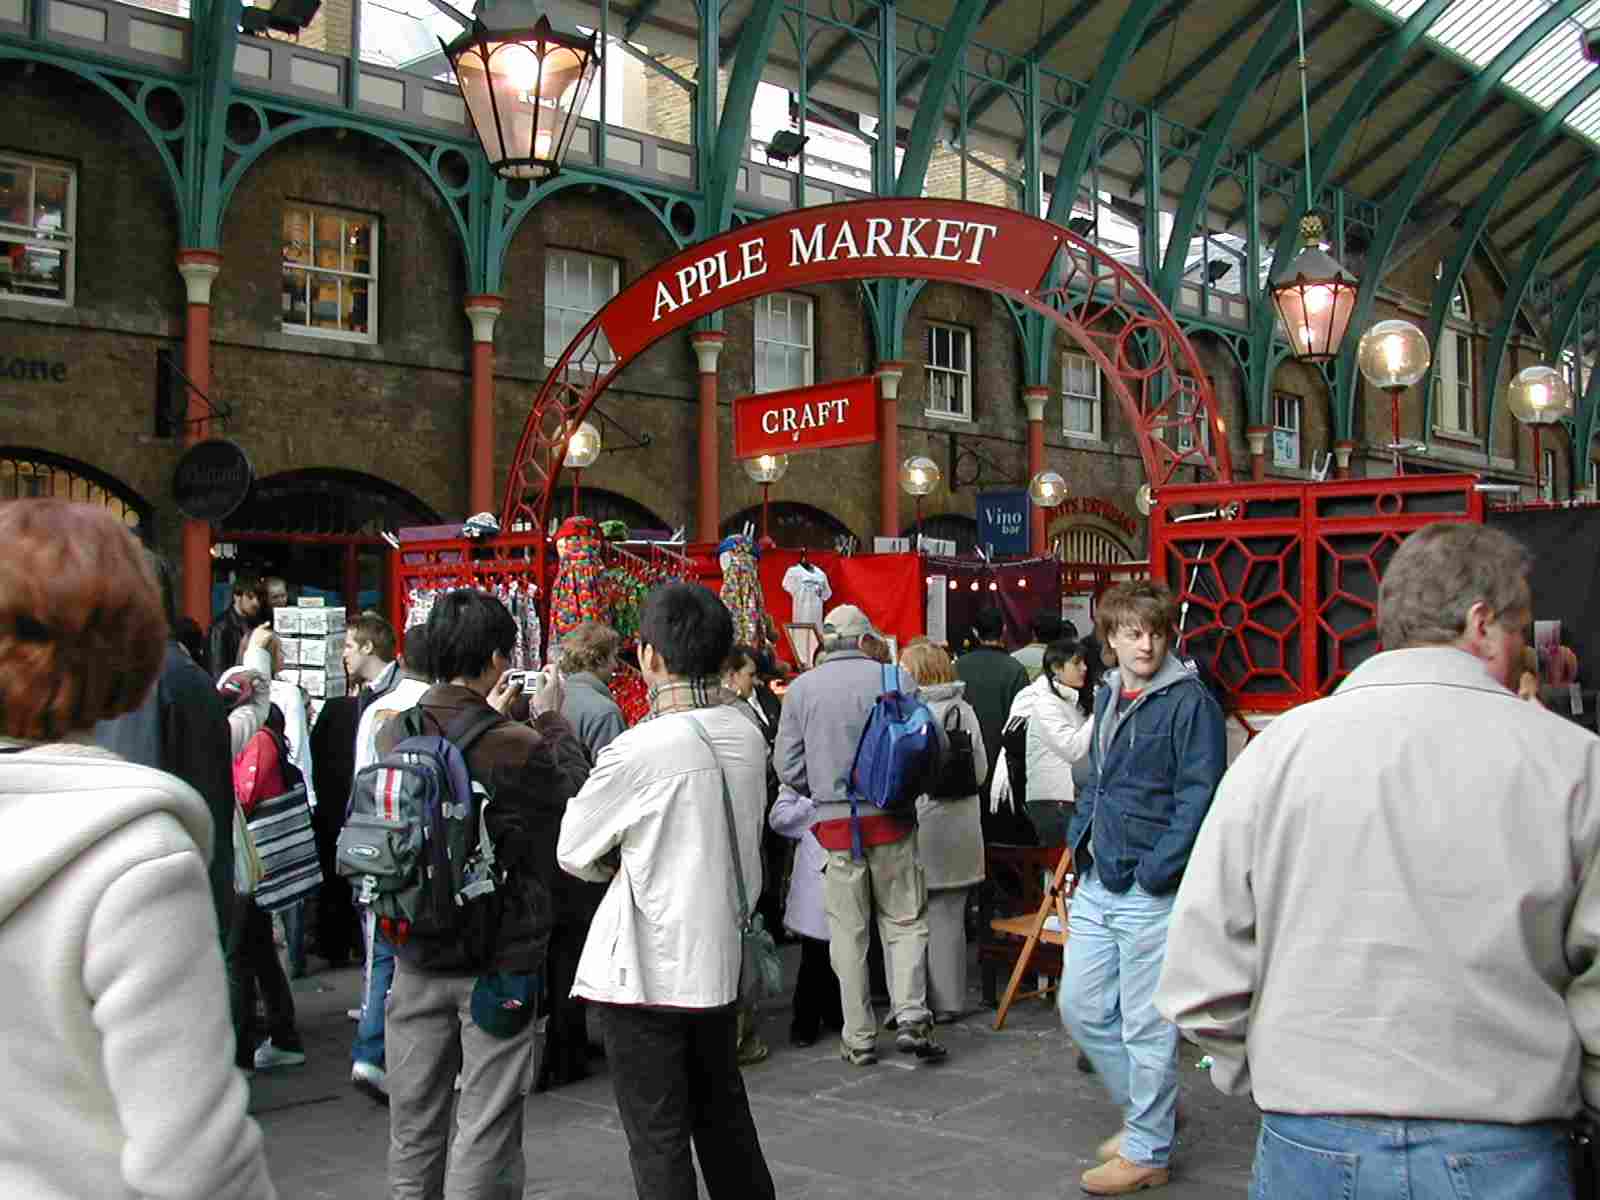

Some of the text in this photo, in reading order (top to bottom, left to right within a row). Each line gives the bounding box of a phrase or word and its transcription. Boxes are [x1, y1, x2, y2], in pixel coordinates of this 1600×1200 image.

[651, 217, 997, 322] APPLE MARKET
[761, 397, 849, 434] CRAFT
[985, 506, 1023, 525] Vino
[1001, 525, 1021, 535] bar
